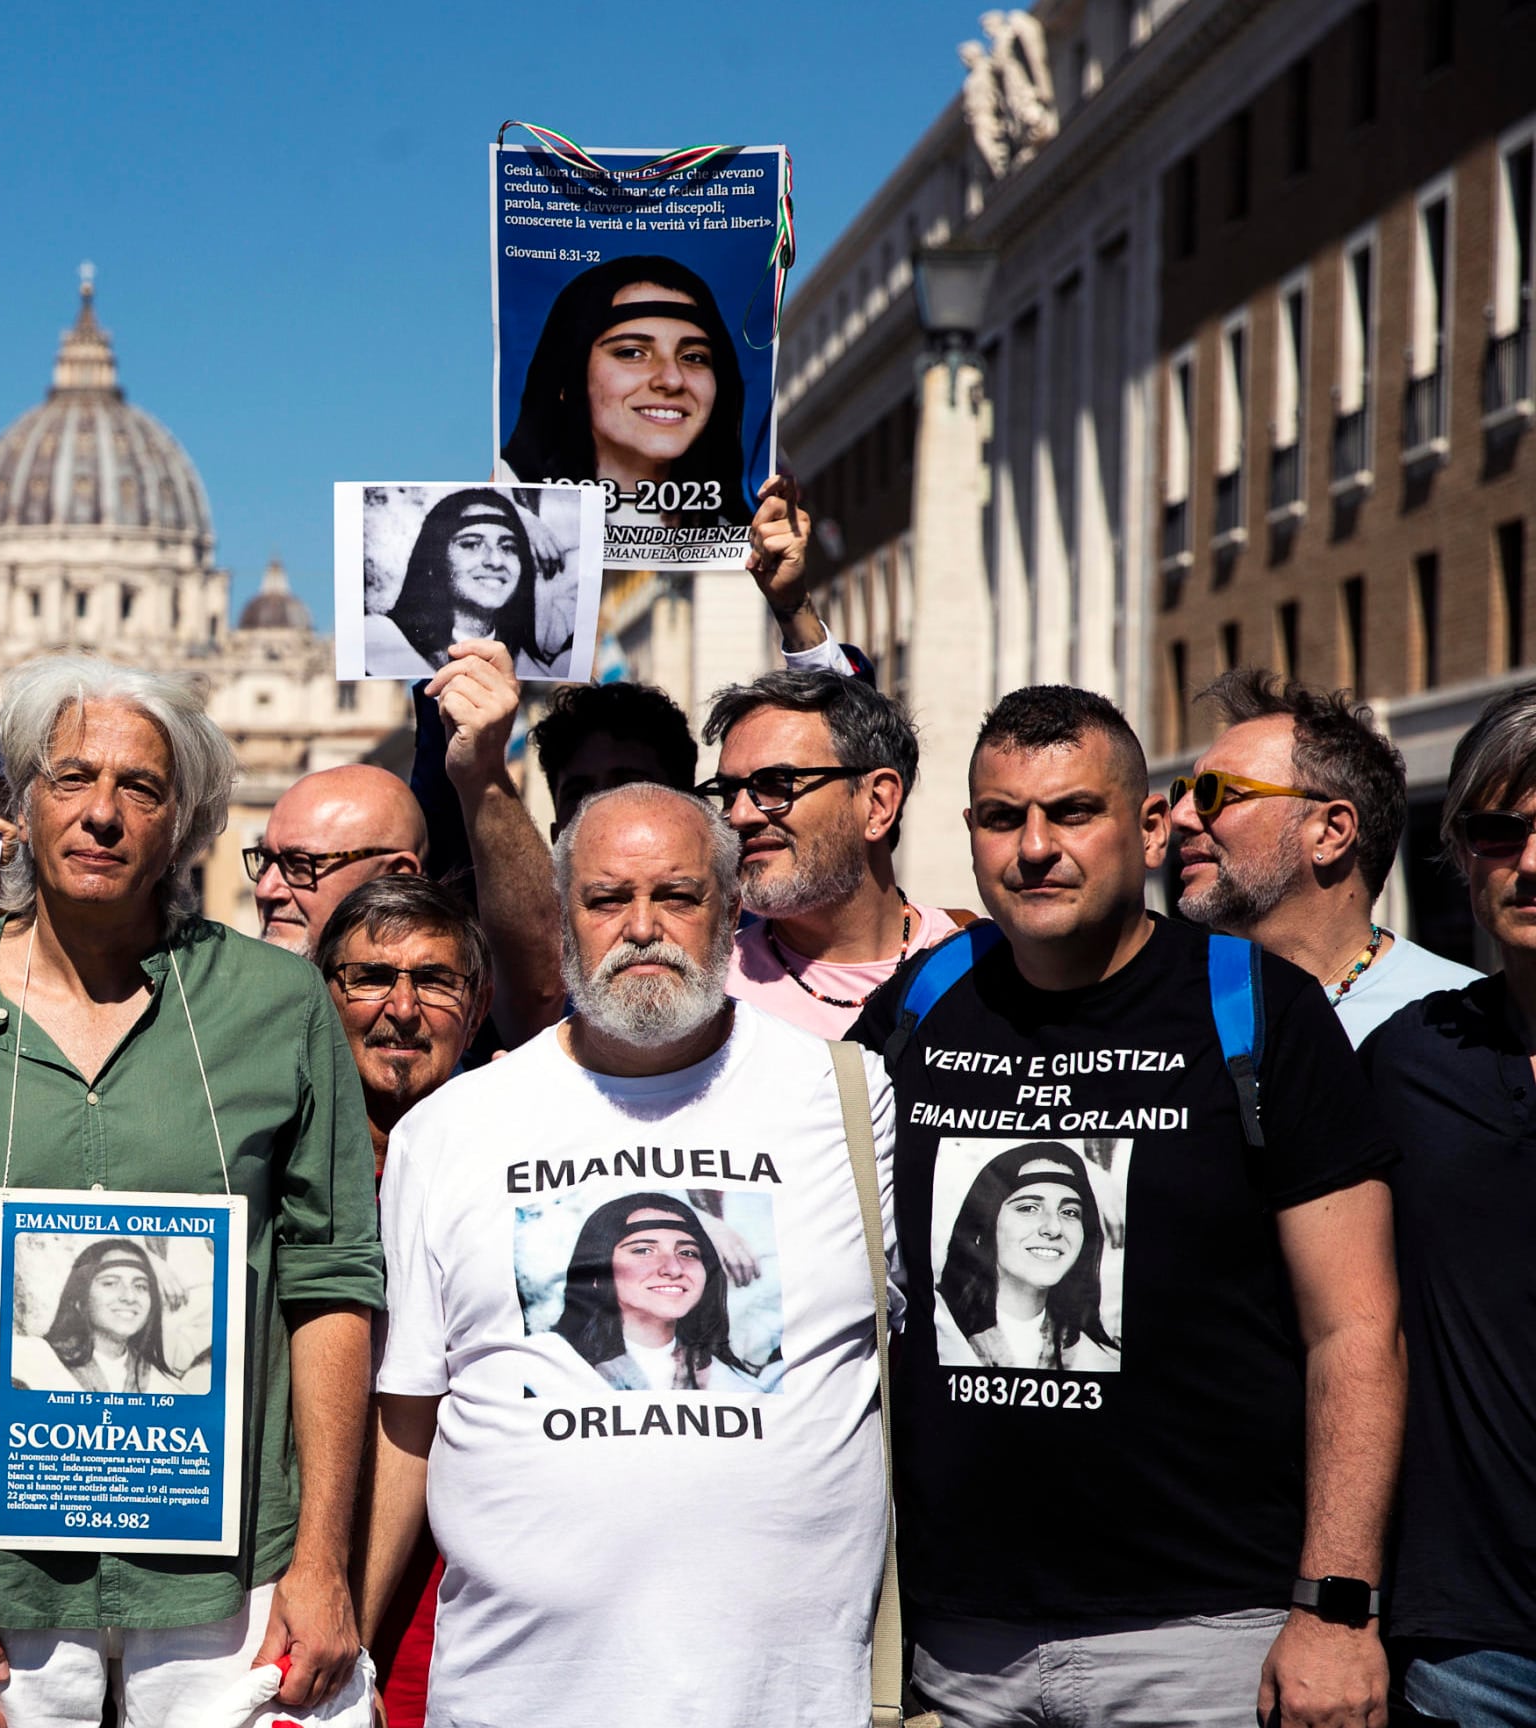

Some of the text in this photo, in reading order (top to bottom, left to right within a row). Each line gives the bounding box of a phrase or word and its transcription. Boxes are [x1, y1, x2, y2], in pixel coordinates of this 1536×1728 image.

[504, 164, 533, 176] Gesù
[536, 165, 568, 178] allora
[686, 168, 709, 179] che
[712, 168, 764, 179] avevano
[504, 182, 549, 194] creduto
[551, 182, 563, 194] in
[565, 183, 585, 196] lui:
[611, 184, 666, 198] rimanete
[669, 185, 704, 197] fedeli
[706, 184, 728, 196] alla
[732, 183, 755, 195] mia
[504, 198, 725, 216] parola, sarete davvero miei discepoli;
[504, 215, 573, 228] conoscerete
[576, 217, 586, 229] la
[589, 217, 623, 230] verità
[626, 221, 633, 230] e
[636, 218, 646, 230] la
[649, 218, 685, 230] verità
[688, 218, 700, 230] vi
[703, 217, 728, 230] farà
[505, 246, 557, 260] Giovanni
[650, 527, 673, 543] DI
[676, 526, 752, 543] SILENZI
[680, 546, 744, 560] ORLANDI
[924, 1046, 1186, 1078] VERITA' E GIUSTIZIA
[1016, 1085, 1072, 1107] PER
[910, 1102, 1188, 1132] EMANUELA ORLANDI
[507, 1146, 783, 1193] EMANUELA
[15, 1213, 215, 1234] EMANUELA ORLANDI
[948, 1373, 1103, 1410] 1983/2023
[47, 1393, 75, 1405] Anni
[79, 1394, 92, 1405] 15
[103, 1395, 124, 1406] alta
[127, 1396, 146, 1407] mt.
[150, 1396, 175, 1408] 1,60
[102, 1408, 112, 1425] È
[542, 1404, 764, 1441] ORLANDI
[9, 1422, 210, 1454] SCOMPARSA
[8, 1452, 19, 1461] Al
[20, 1454, 59, 1462] momento
[60, 1453, 80, 1462] della
[82, 1454, 125, 1464] scomparsa
[152, 1456, 179, 1466] capelli
[182, 1456, 210, 1467] lunghi,
[8, 1462, 24, 1470] neri
[39, 1462, 58, 1472] lisci,
[63, 1463, 102, 1472] indossava
[107, 1465, 146, 1475] pantaloni
[150, 1466, 174, 1475] jeans,
[179, 1467, 210, 1475] camicia
[7, 1471, 34, 1480] bianca
[44, 1474, 70, 1483] scarpe
[72, 1473, 83, 1481] da
[85, 1474, 129, 1483] ginnastica.
[7, 1481, 25, 1490] Non
[27, 1481, 34, 1490] si
[35, 1482, 61, 1491] hanno
[79, 1483, 107, 1492] notizie
[108, 1484, 129, 1493] dalle
[148, 1485, 158, 1494] 19
[159, 1485, 167, 1494] di
[169, 1486, 210, 1495] mercoledì
[7, 1491, 209, 1507] 22 giugno, chi avesse utili informazioni è pregato di
[7, 1501, 47, 1510] telefonare
[50, 1502, 57, 1510] al
[64, 1512, 150, 1529] 69.84.982
